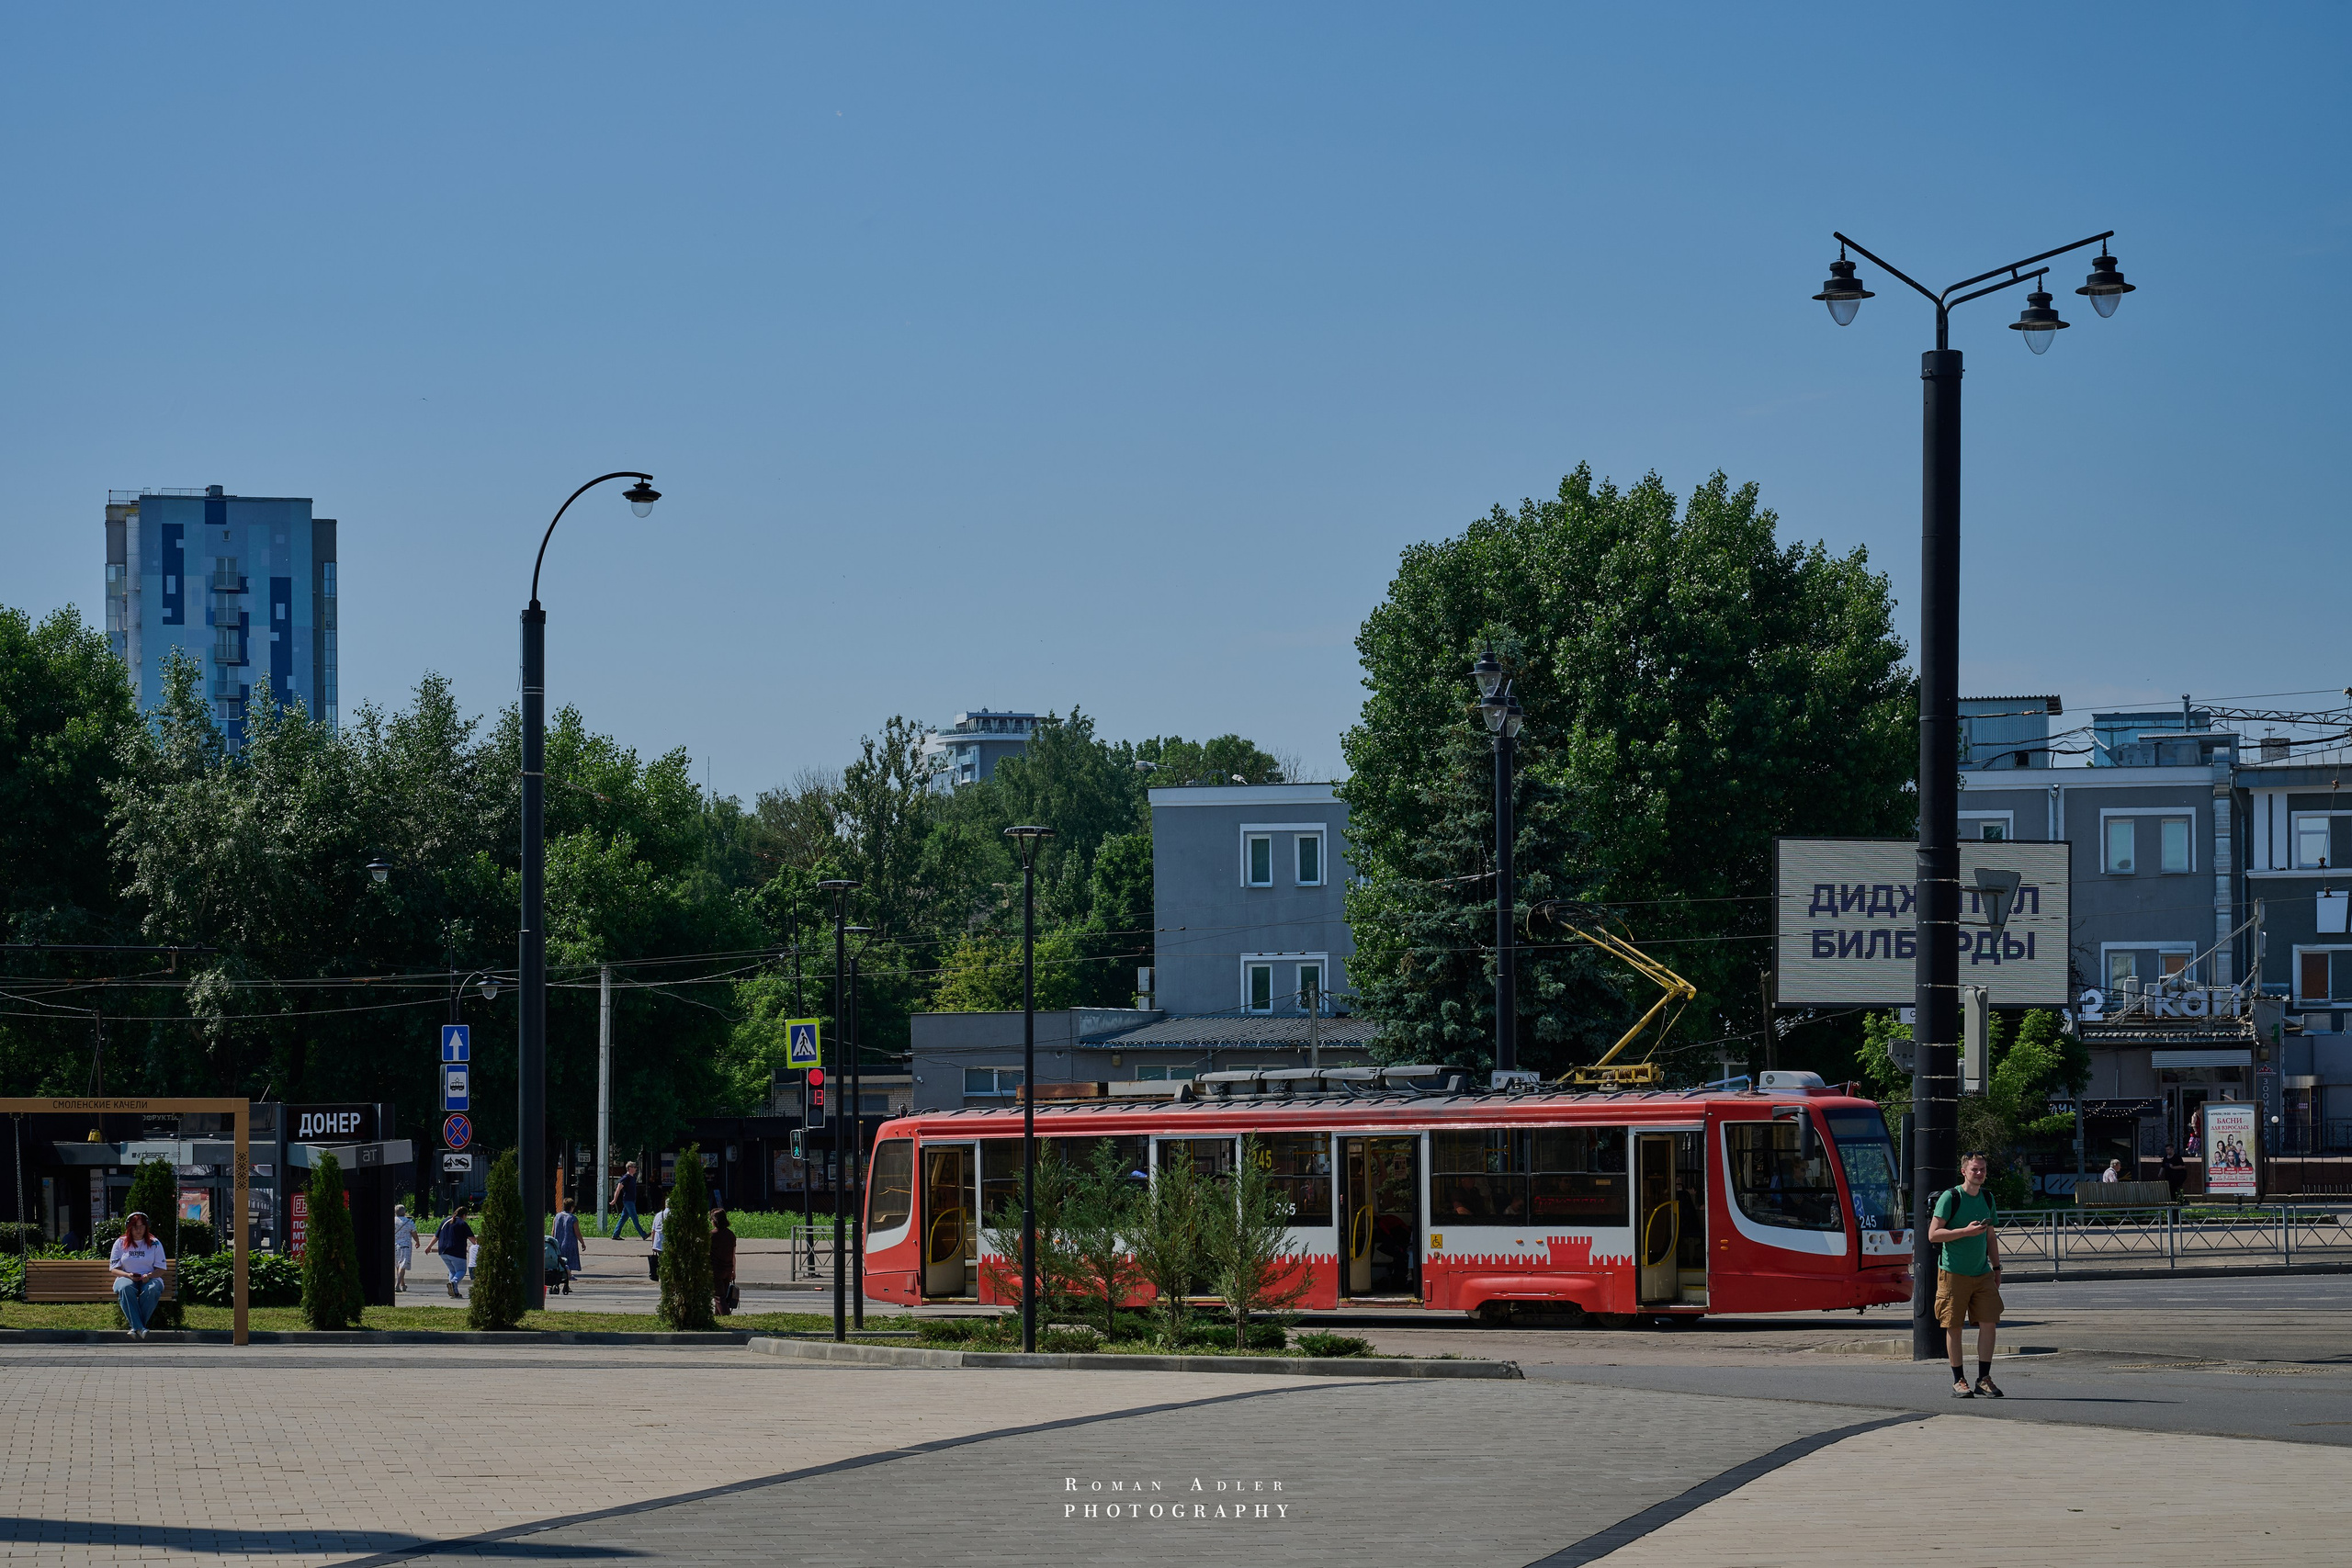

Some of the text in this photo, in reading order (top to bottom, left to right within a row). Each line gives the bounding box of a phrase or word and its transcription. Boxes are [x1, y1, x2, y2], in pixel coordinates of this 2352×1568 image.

[1813, 930, 2035, 964] БИЛБРДЫ
[2154, 984, 2242, 1017] kari
[52, 1100, 148, 1109] СМОЛЕНСКИЕ КАЧЕЛИ
[814, 1089, 824, 1105] 13
[299, 1112, 361, 1137] ДОНЕР
[1251, 1149, 1272, 1168] 245
[1859, 1214, 1877, 1228] 245
